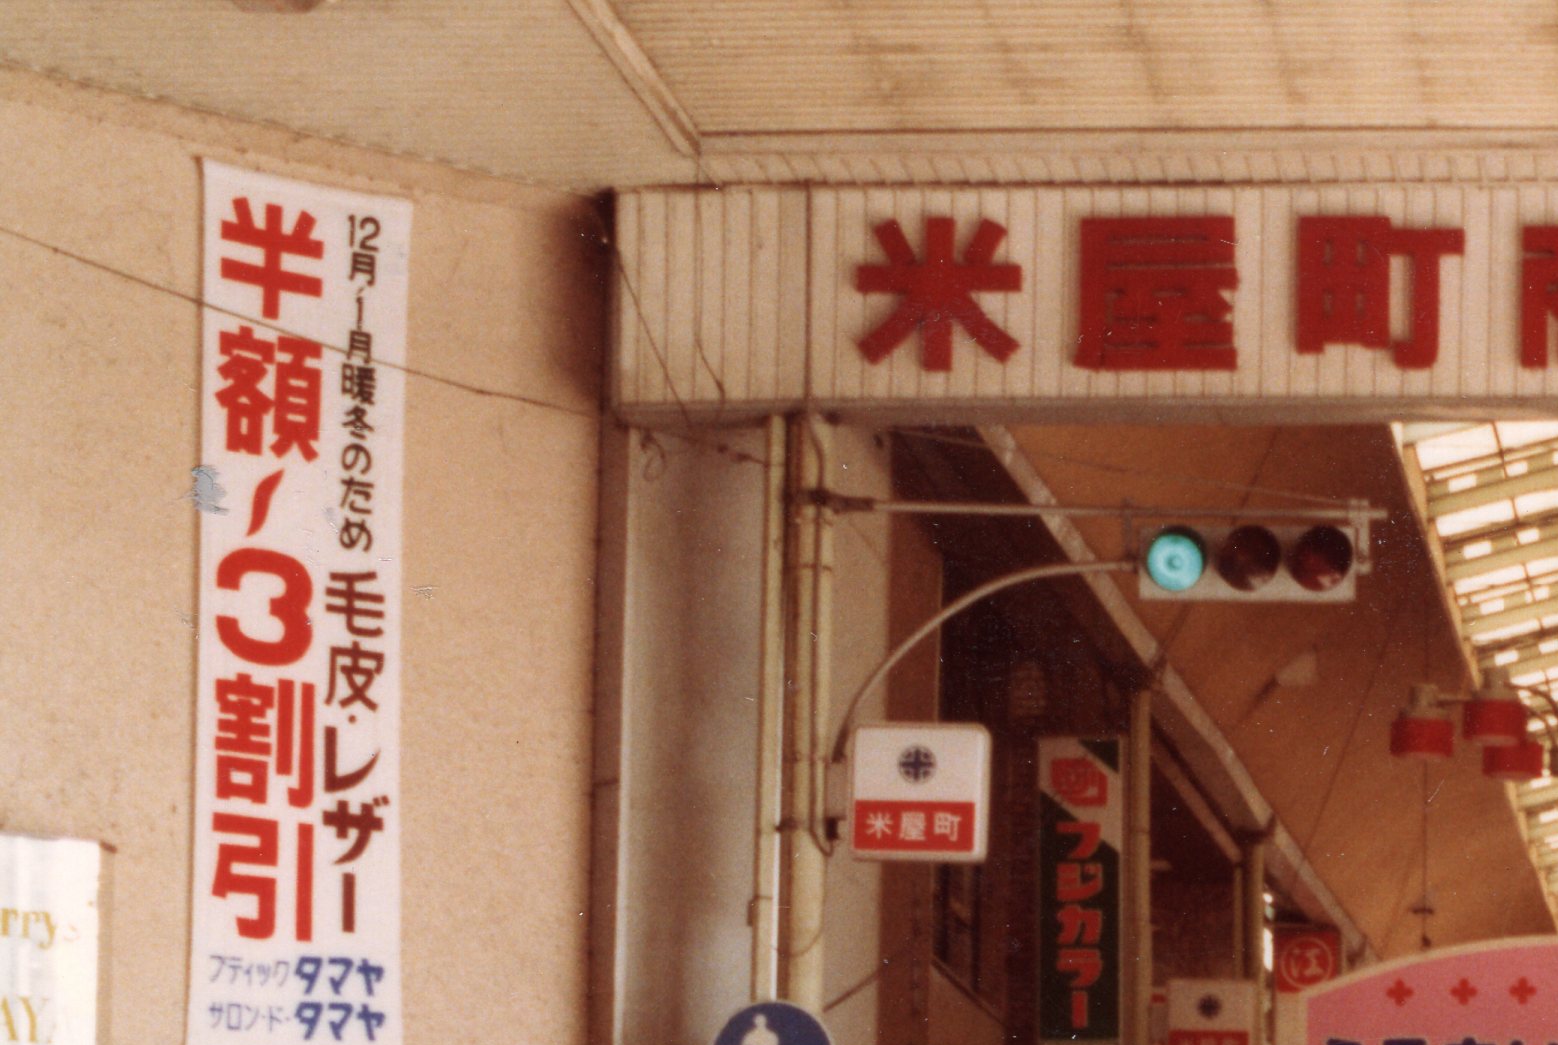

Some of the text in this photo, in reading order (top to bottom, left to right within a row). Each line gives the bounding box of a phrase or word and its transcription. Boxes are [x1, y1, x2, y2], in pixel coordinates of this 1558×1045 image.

[865, 810, 963, 843] 米屋町
[1056, 820, 1103, 1029] フジカラー
